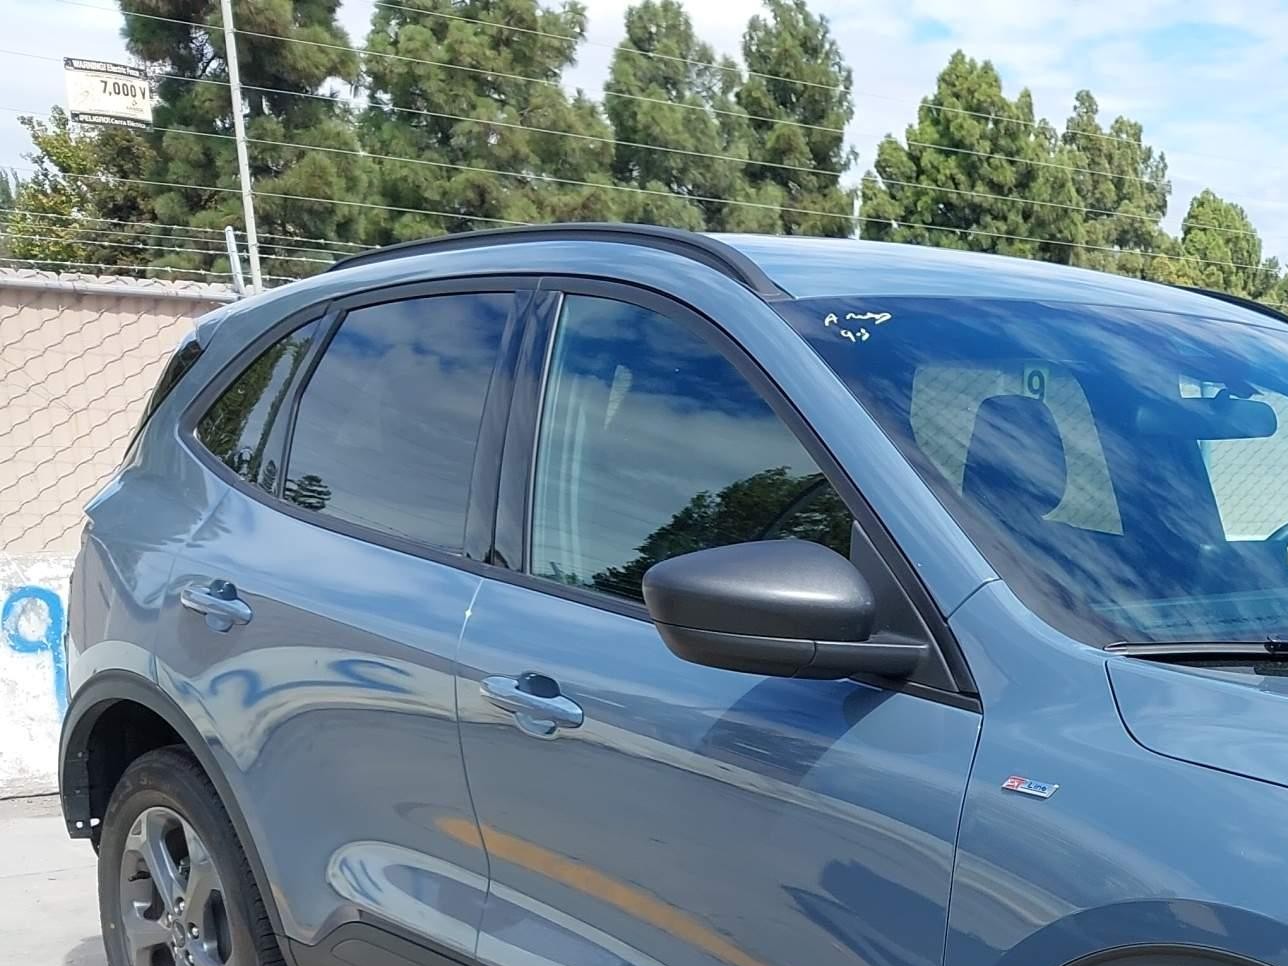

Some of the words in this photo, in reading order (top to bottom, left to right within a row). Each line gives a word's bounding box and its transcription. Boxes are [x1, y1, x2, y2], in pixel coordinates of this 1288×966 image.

[100, 79, 137, 98] 7,000
[138, 86, 147, 100] V
[1027, 369, 1046, 398] 9
